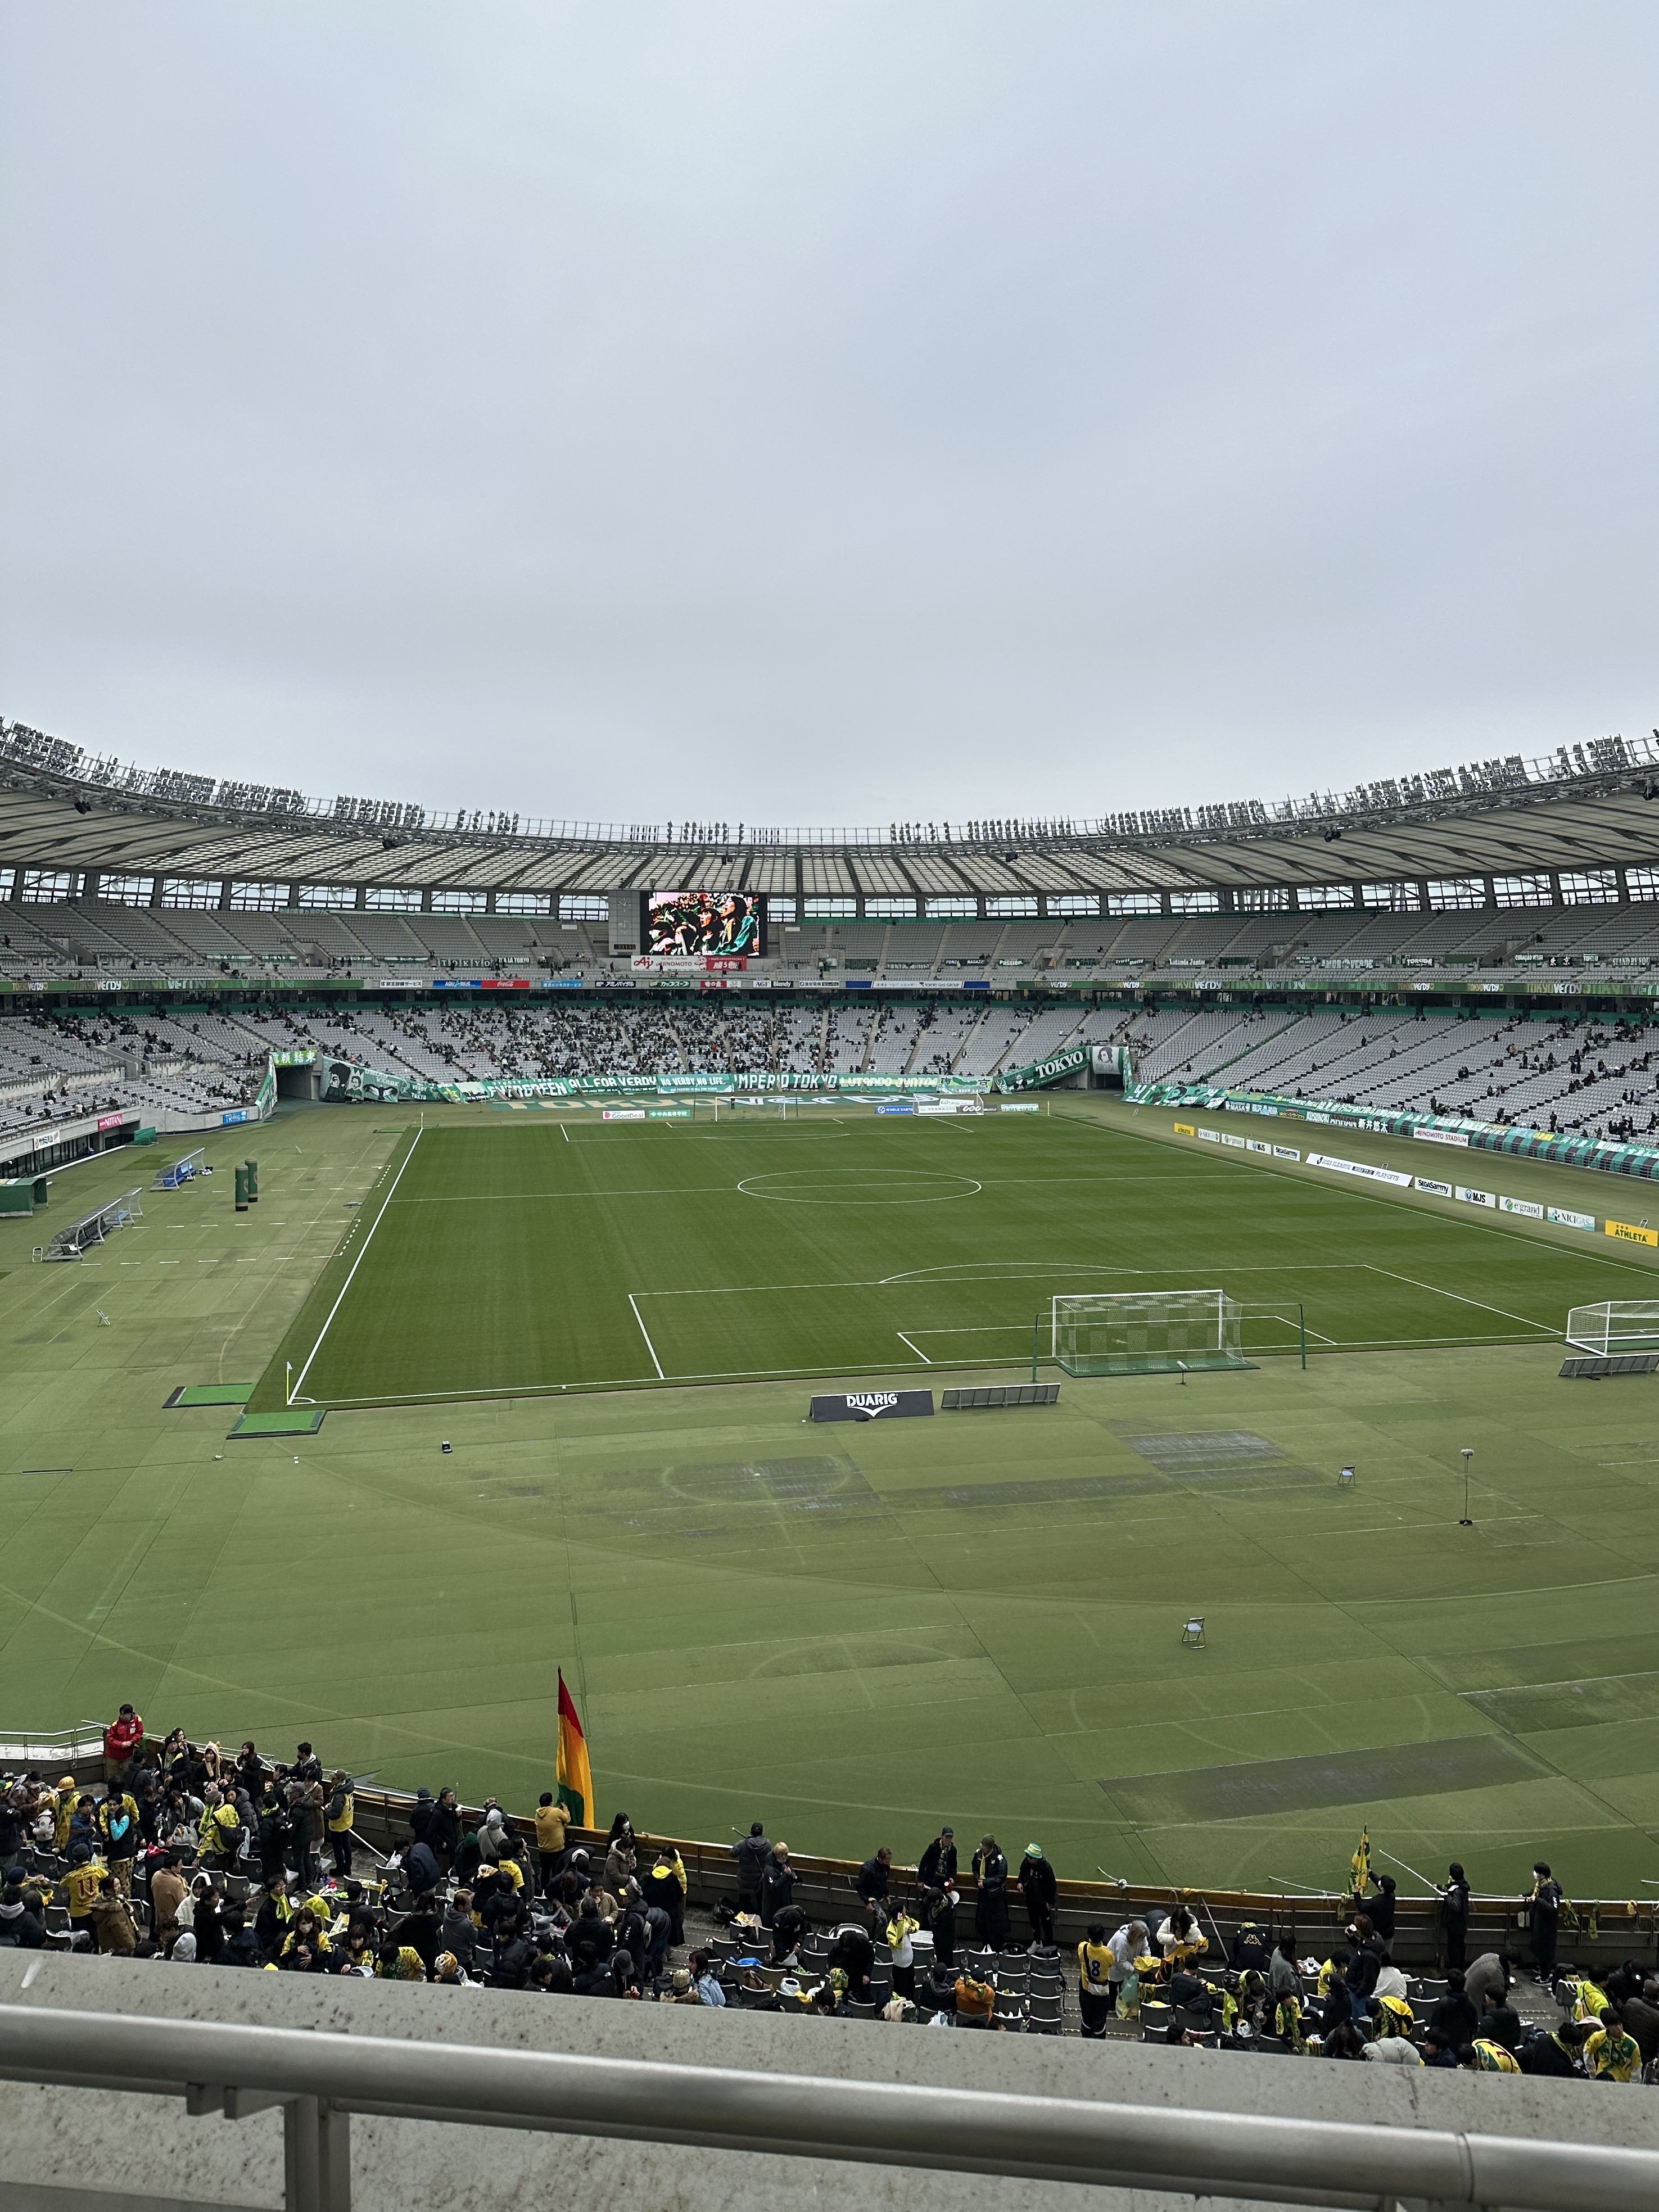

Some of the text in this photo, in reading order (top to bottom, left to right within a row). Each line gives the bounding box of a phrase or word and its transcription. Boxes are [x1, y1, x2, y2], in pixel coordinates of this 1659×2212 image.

[1036, 1051, 1083, 1078] TOKYO
[568, 1076, 657, 1088] ALL FOR VERDY
[661, 1078, 671, 1087] NO
[793, 1074, 838, 1089] TOKYO
[1358, 1118, 1388, 1133] 新井悠太
[1415, 1129, 1467, 1143] AJINOMOTO STADIUM
[1472, 1192, 1486, 1203] MJS
[1562, 1213, 1590, 1225] NICIGAS
[1615, 1229, 1647, 1243] ATHLETA
[846, 1393, 898, 1406] DUARIG
[78, 1876, 93, 1898] 11
[1091, 1960, 1100, 1976] 8
